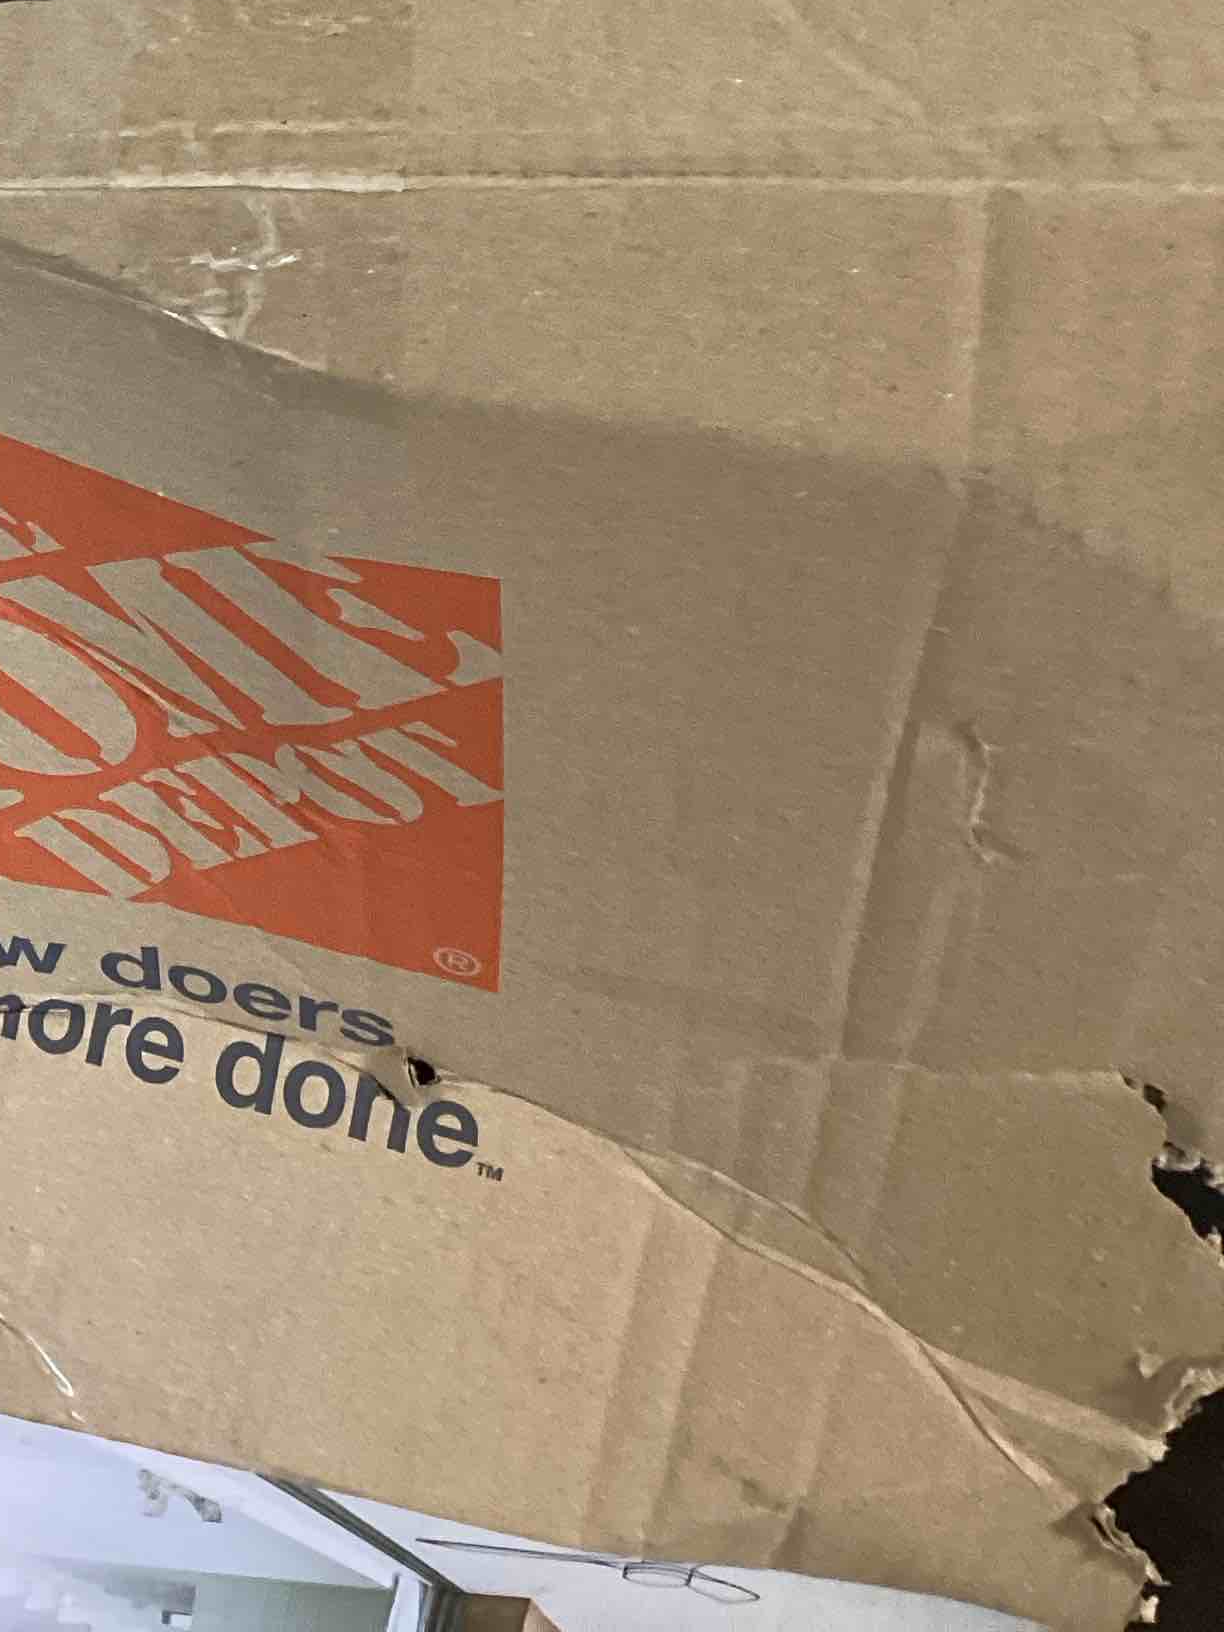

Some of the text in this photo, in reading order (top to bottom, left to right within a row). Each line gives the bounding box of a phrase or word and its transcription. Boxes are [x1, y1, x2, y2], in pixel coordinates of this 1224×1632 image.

[13, 720, 505, 901] DEPOT
[101, 945, 396, 1048] doers
[214, 1032, 480, 1170] done
